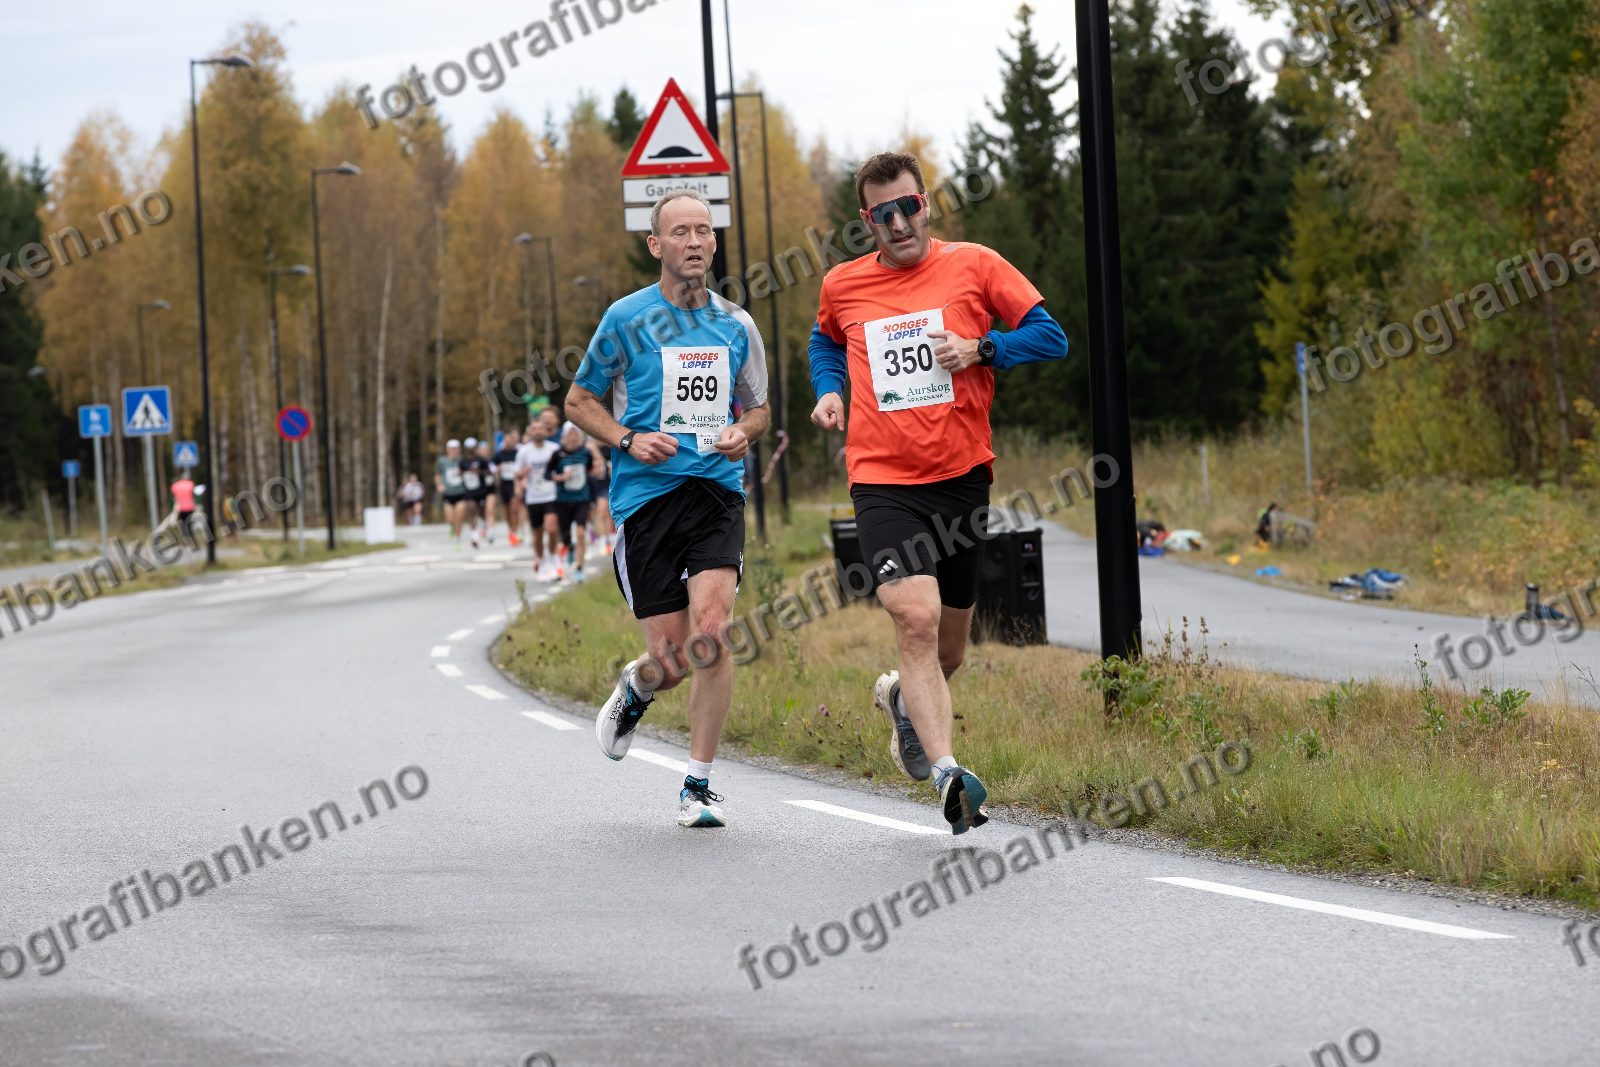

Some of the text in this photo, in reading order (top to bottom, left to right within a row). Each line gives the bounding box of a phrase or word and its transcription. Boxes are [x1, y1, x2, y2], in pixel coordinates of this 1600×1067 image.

[883, 318, 928, 333] NORGES
[887, 328, 922, 341] LØPET
[677, 352, 719, 361] NORGES
[884, 343, 933, 377] 350
[682, 361, 713, 369] LØPET
[676, 375, 718, 402] 569
[907, 383, 951, 397] Aurskog
[690, 413, 726, 424] Aurskog
